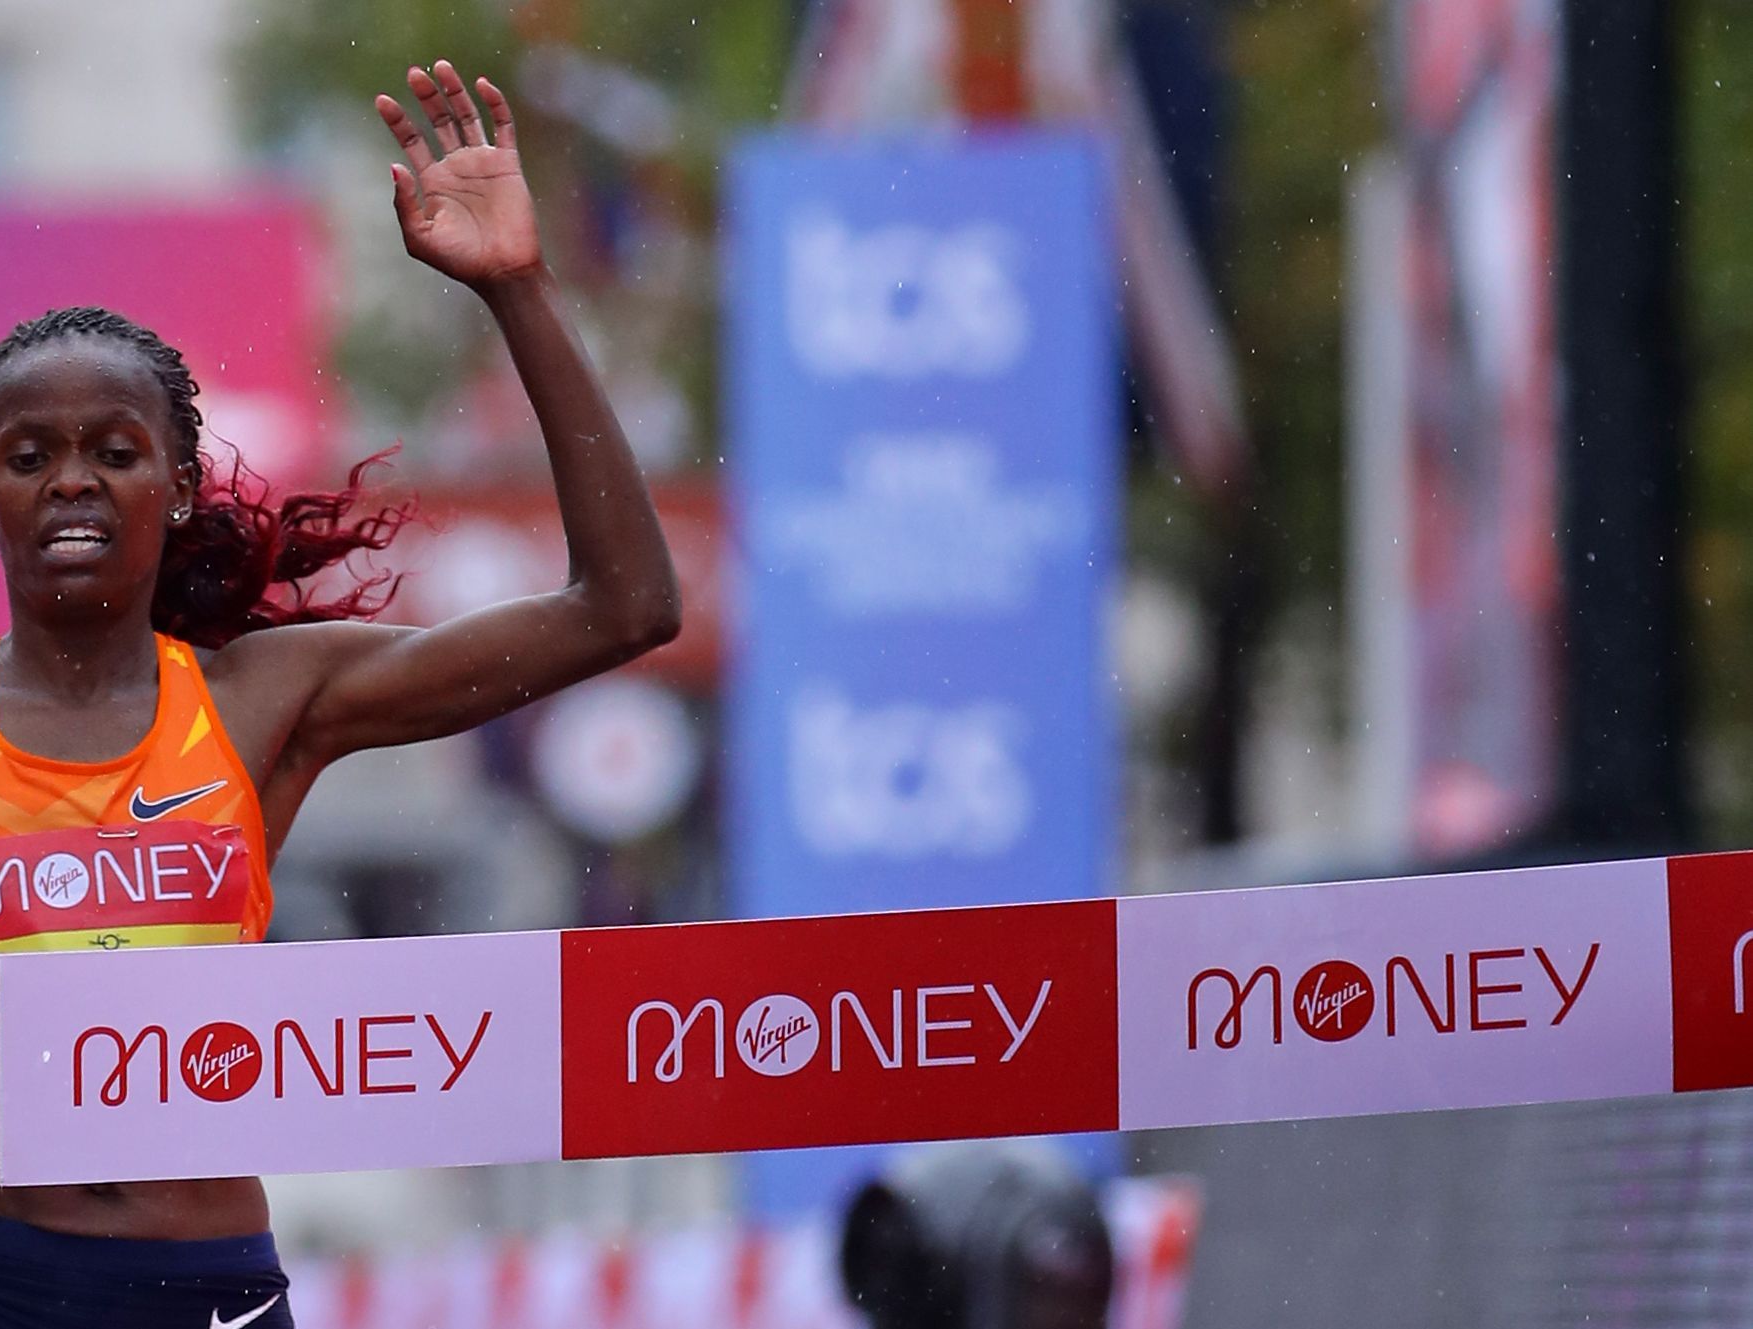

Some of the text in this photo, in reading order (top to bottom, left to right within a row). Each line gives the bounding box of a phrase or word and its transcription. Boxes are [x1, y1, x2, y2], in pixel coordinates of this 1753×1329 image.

[39, 862, 83, 899] Virgin
[1188, 943, 1600, 1050] MONEY
[1301, 973, 1366, 1028] Virgin
[74, 1012, 492, 1107] MONEY
[628, 981, 1052, 1083] MONEY
[743, 1006, 811, 1064] Virgin
[187, 1034, 253, 1089] Virgin
